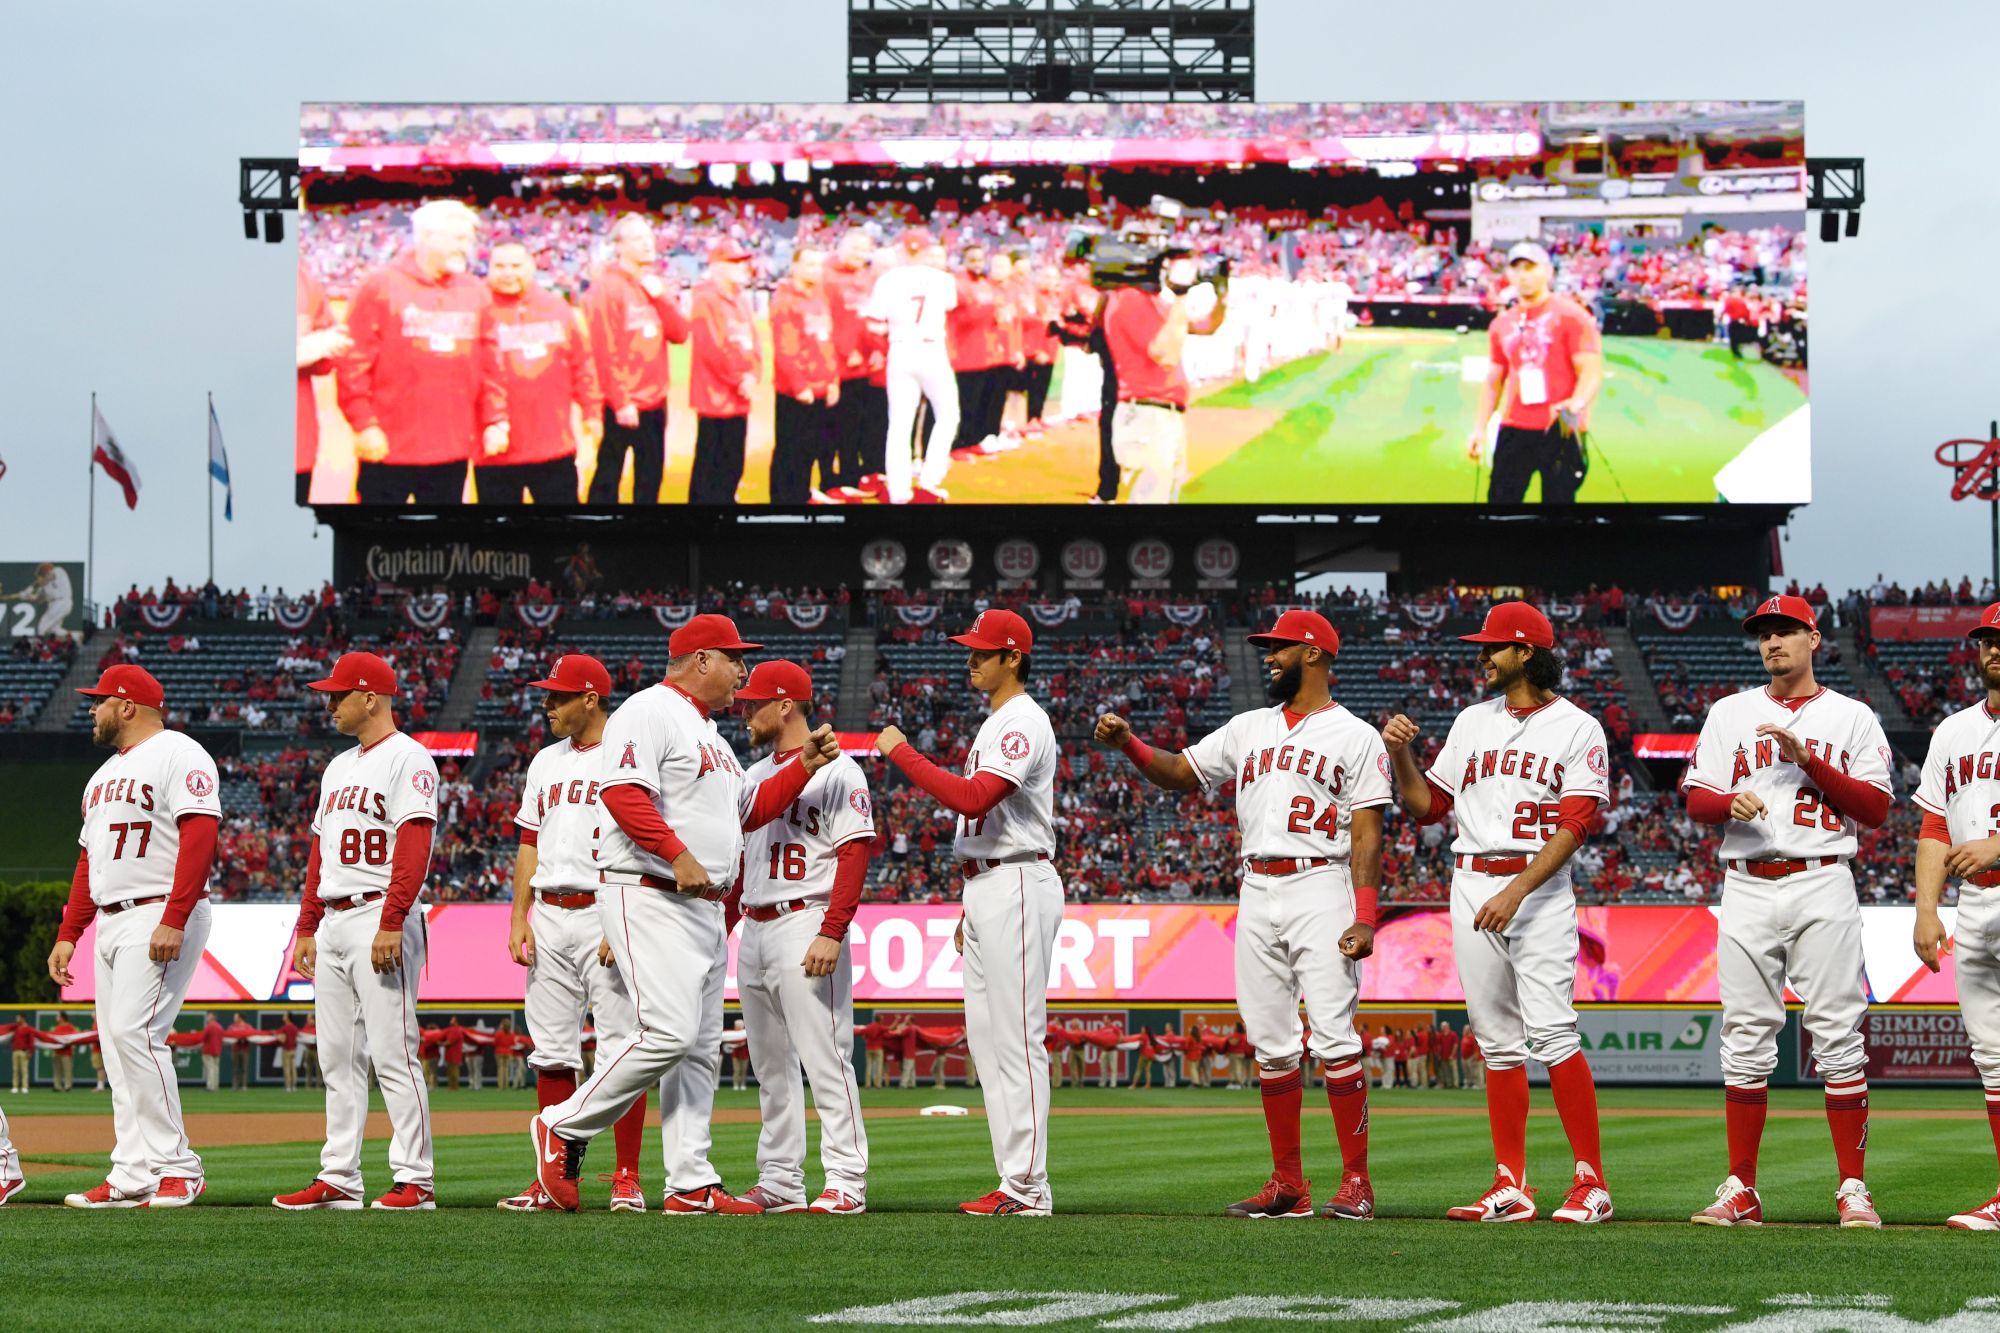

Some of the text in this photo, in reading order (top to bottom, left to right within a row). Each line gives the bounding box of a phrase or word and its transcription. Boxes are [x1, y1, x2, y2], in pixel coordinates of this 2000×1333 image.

[910, 295, 926, 324] 7
[366, 541, 530, 583] Captain Morgan
[1002, 544, 1034, 570] 29
[1068, 545, 1101, 570] 30
[1134, 546, 1167, 570] 42
[1201, 546, 1233, 570] 50
[696, 739, 742, 780] ANGE
[1241, 744, 1345, 796] ANGELS
[1461, 750, 1565, 795] ANGELS
[324, 785, 388, 822] NGELS
[537, 780, 600, 824] ANGE
[1288, 795, 1338, 841] 24
[1512, 801, 1561, 842] 25
[109, 821, 152, 861] 77
[340, 828, 388, 866] 88
[768, 841, 807, 881] 16
[851, 917, 1150, 990] OZRT
[1627, 1064, 1680, 1075] MEMBER
[1892, 1050, 1934, 1065] MAY
